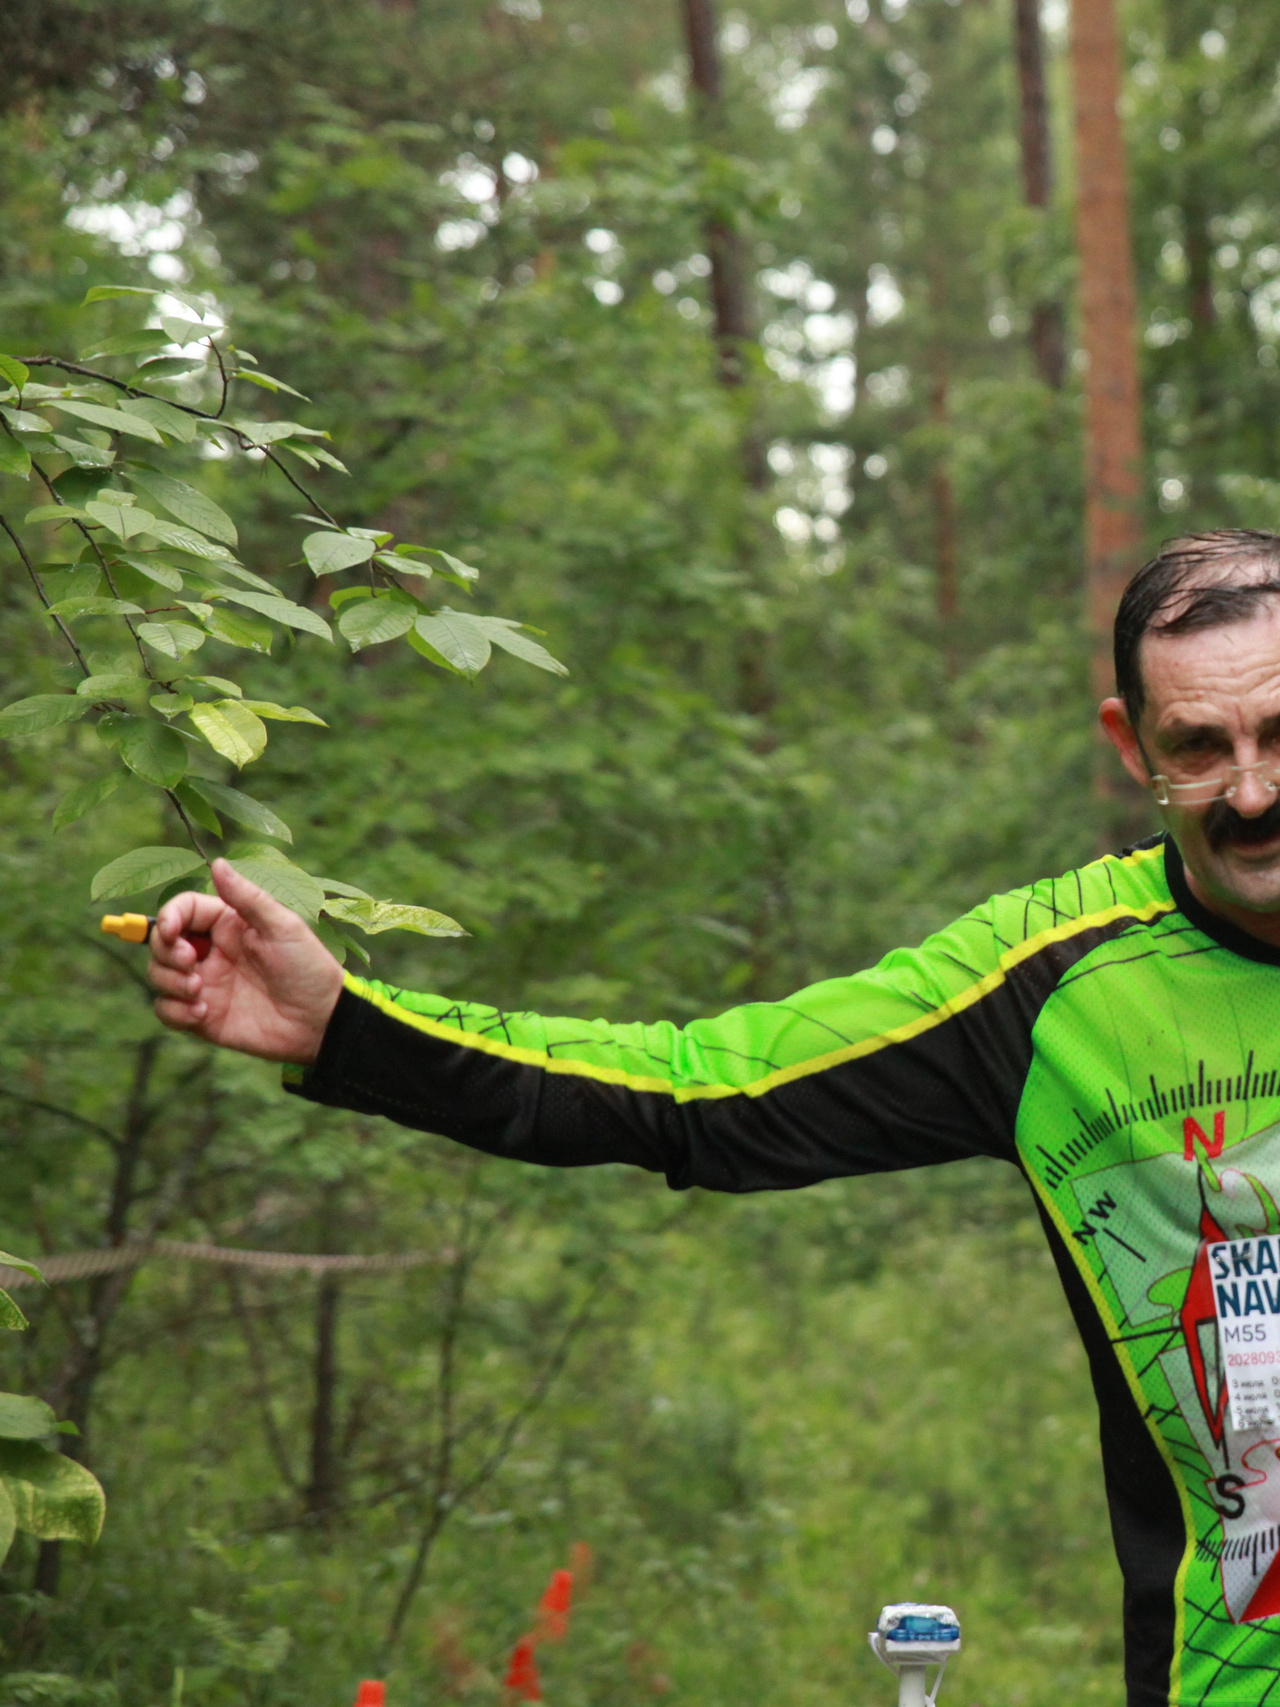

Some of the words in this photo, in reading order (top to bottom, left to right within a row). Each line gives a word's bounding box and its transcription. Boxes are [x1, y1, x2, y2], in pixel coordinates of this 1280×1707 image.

[1183, 1110, 1225, 1161] N
[1072, 1190, 1117, 1246] NW
[1224, 1323, 1267, 1343] M55
[1215, 1473, 1246, 1520] S
